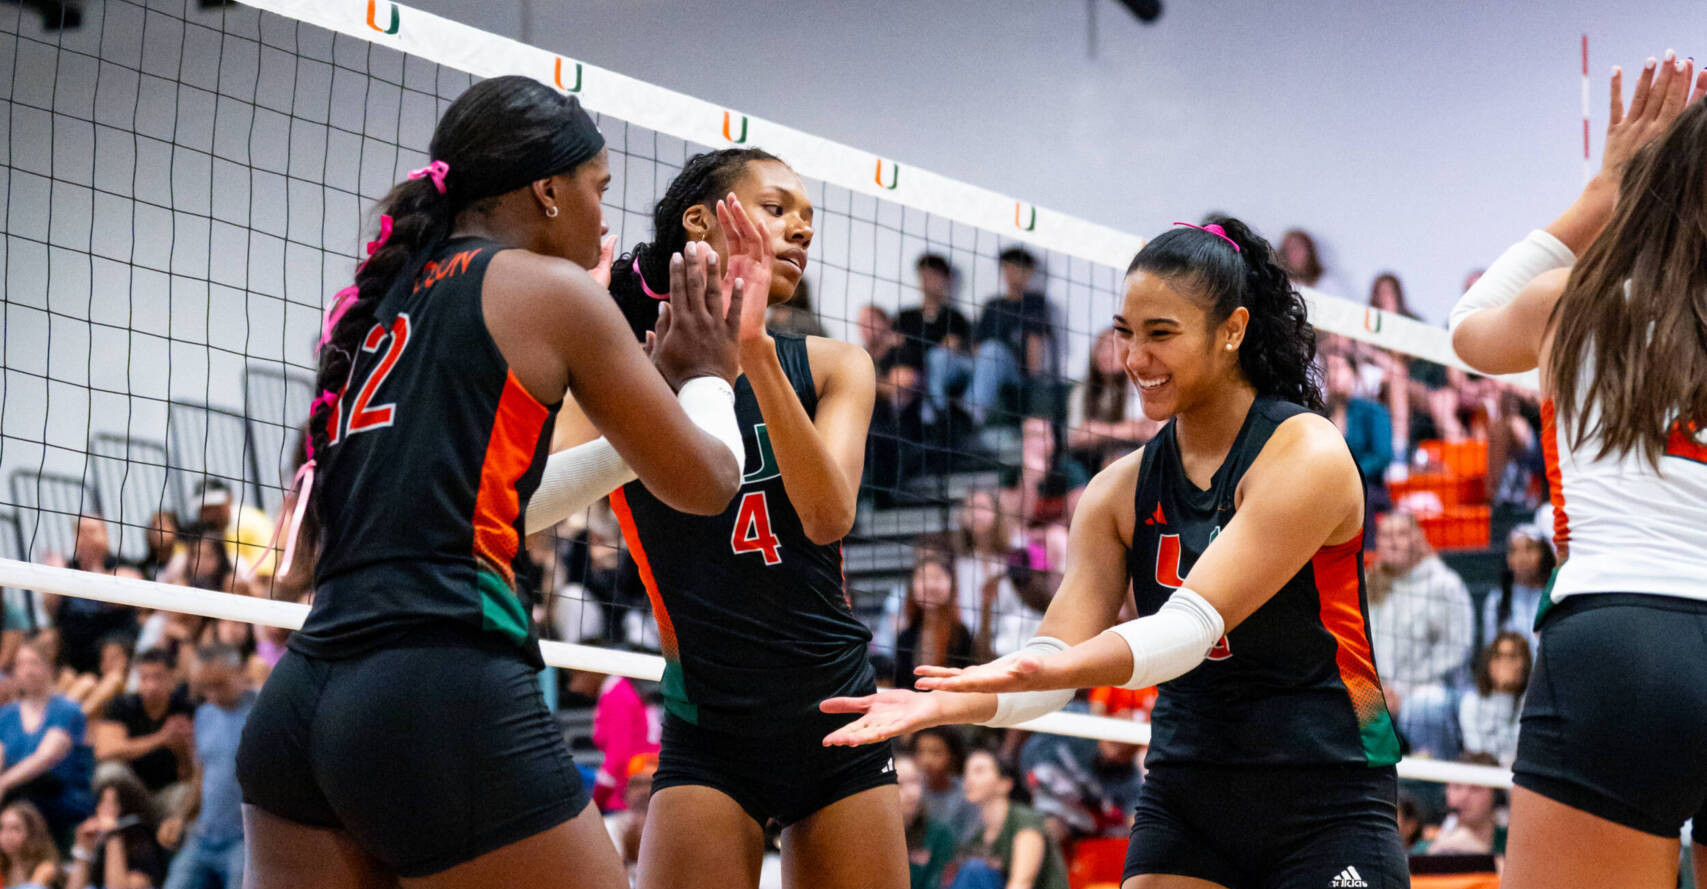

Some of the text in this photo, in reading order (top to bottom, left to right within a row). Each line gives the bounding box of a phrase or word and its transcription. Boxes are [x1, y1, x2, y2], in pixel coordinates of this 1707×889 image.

[366, 0, 400, 35] U
[554, 57, 583, 93] U
[722, 111, 748, 144] U
[875, 158, 899, 190] U
[1015, 202, 1036, 231] U
[1363, 306, 1382, 333] U
[731, 490, 783, 566] 4
